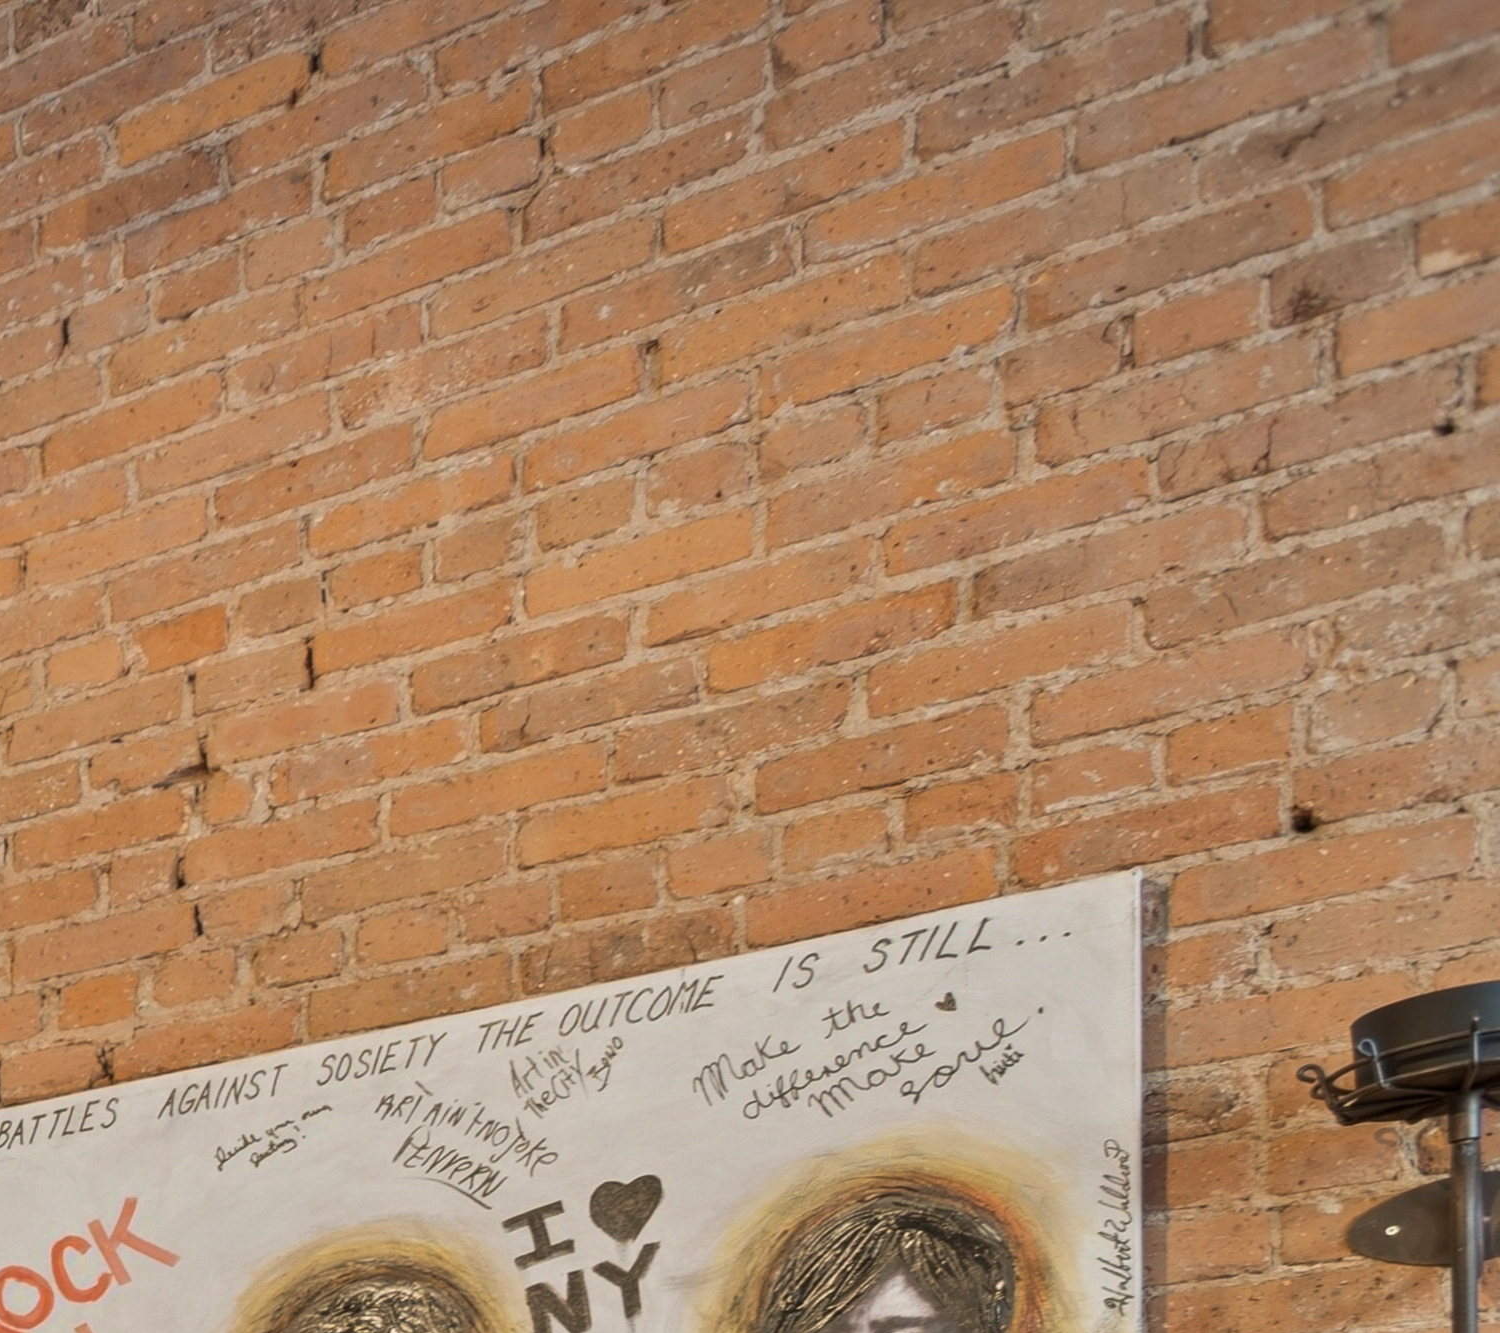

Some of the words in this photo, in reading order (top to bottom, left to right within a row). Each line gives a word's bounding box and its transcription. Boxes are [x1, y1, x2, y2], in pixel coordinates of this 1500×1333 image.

[157, 1063, 289, 1120] AGAINST
[316, 1032, 448, 1087] SOSIETY
[478, 1012, 544, 1055] THE
[558, 974, 724, 1037] OUTCOME
[773, 953, 819, 994] IS
[822, 1000, 889, 1039] the
[743, 1022, 927, 1119] difference
[501, 1200, 575, 1270] I
